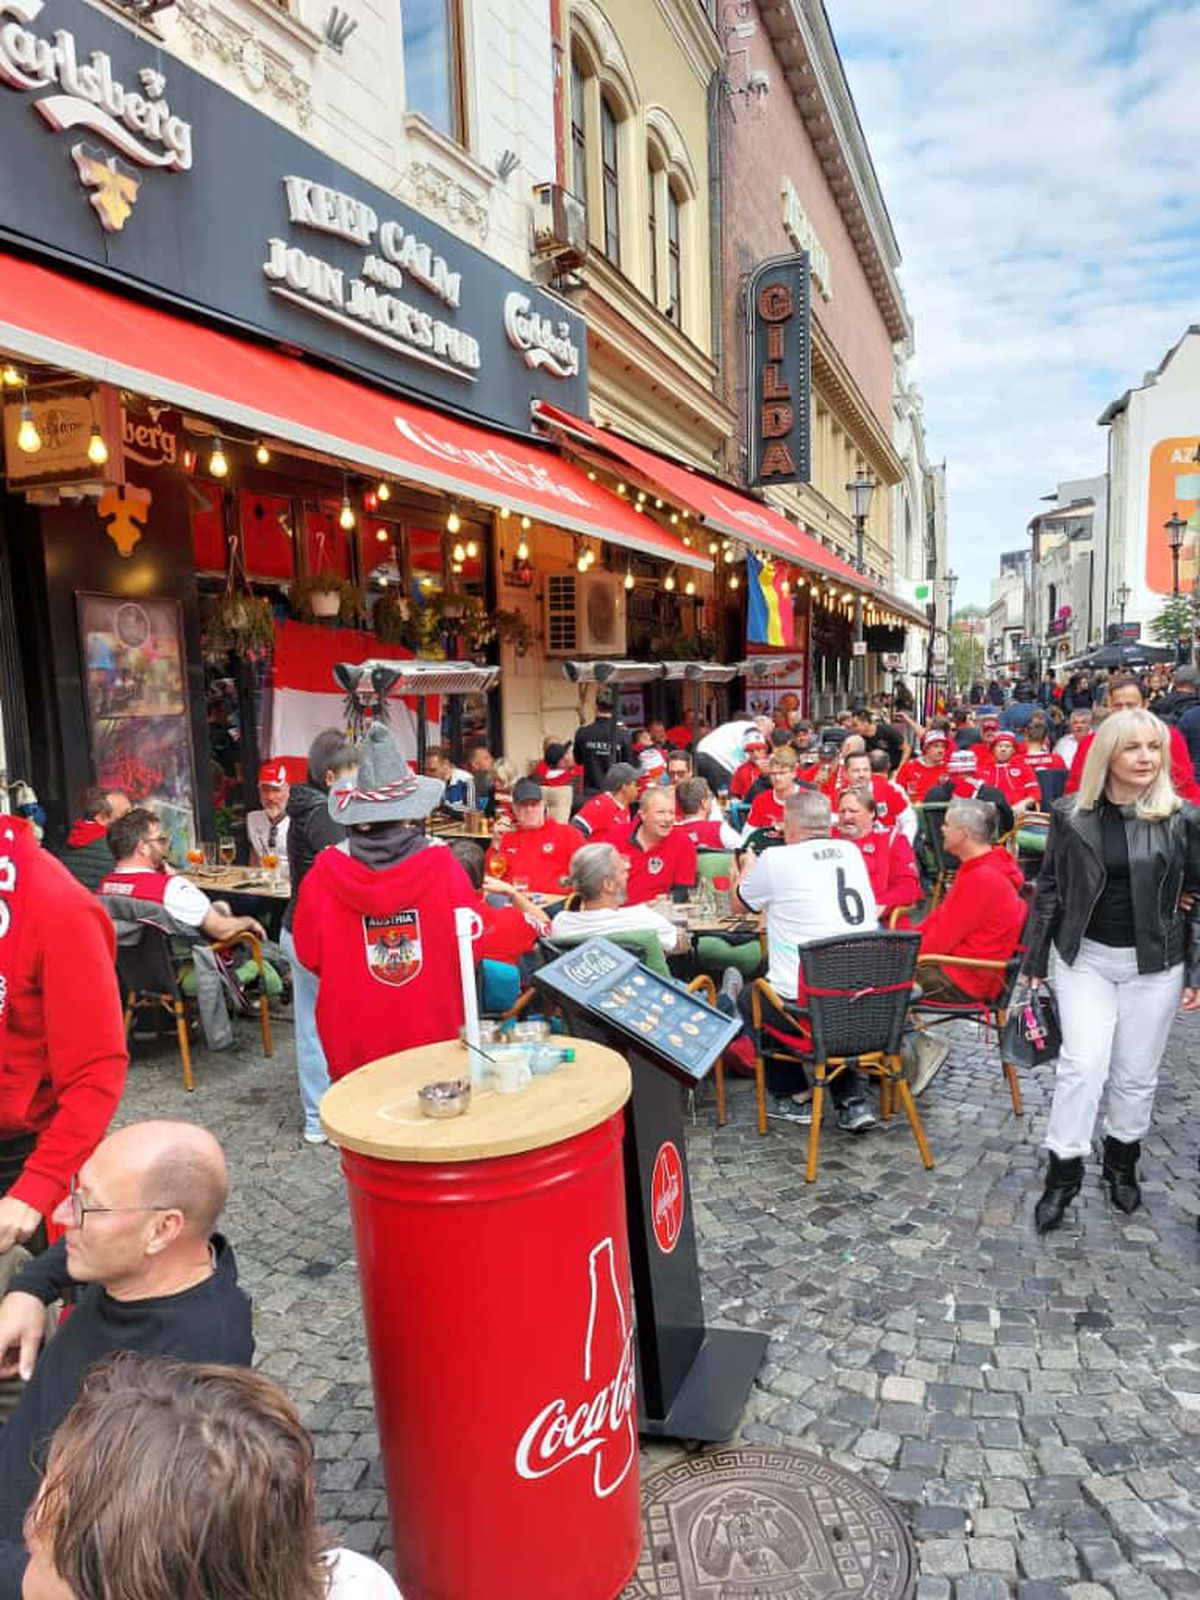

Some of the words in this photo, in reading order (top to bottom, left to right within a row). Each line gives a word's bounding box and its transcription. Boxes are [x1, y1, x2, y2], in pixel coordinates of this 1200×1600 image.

[263, 238, 344, 308] JOIN
[283, 175, 378, 246] KEEP
[380, 222, 462, 310] CALM
[758, 282, 796, 478] GILDA
[836, 867, 865, 926] 6
